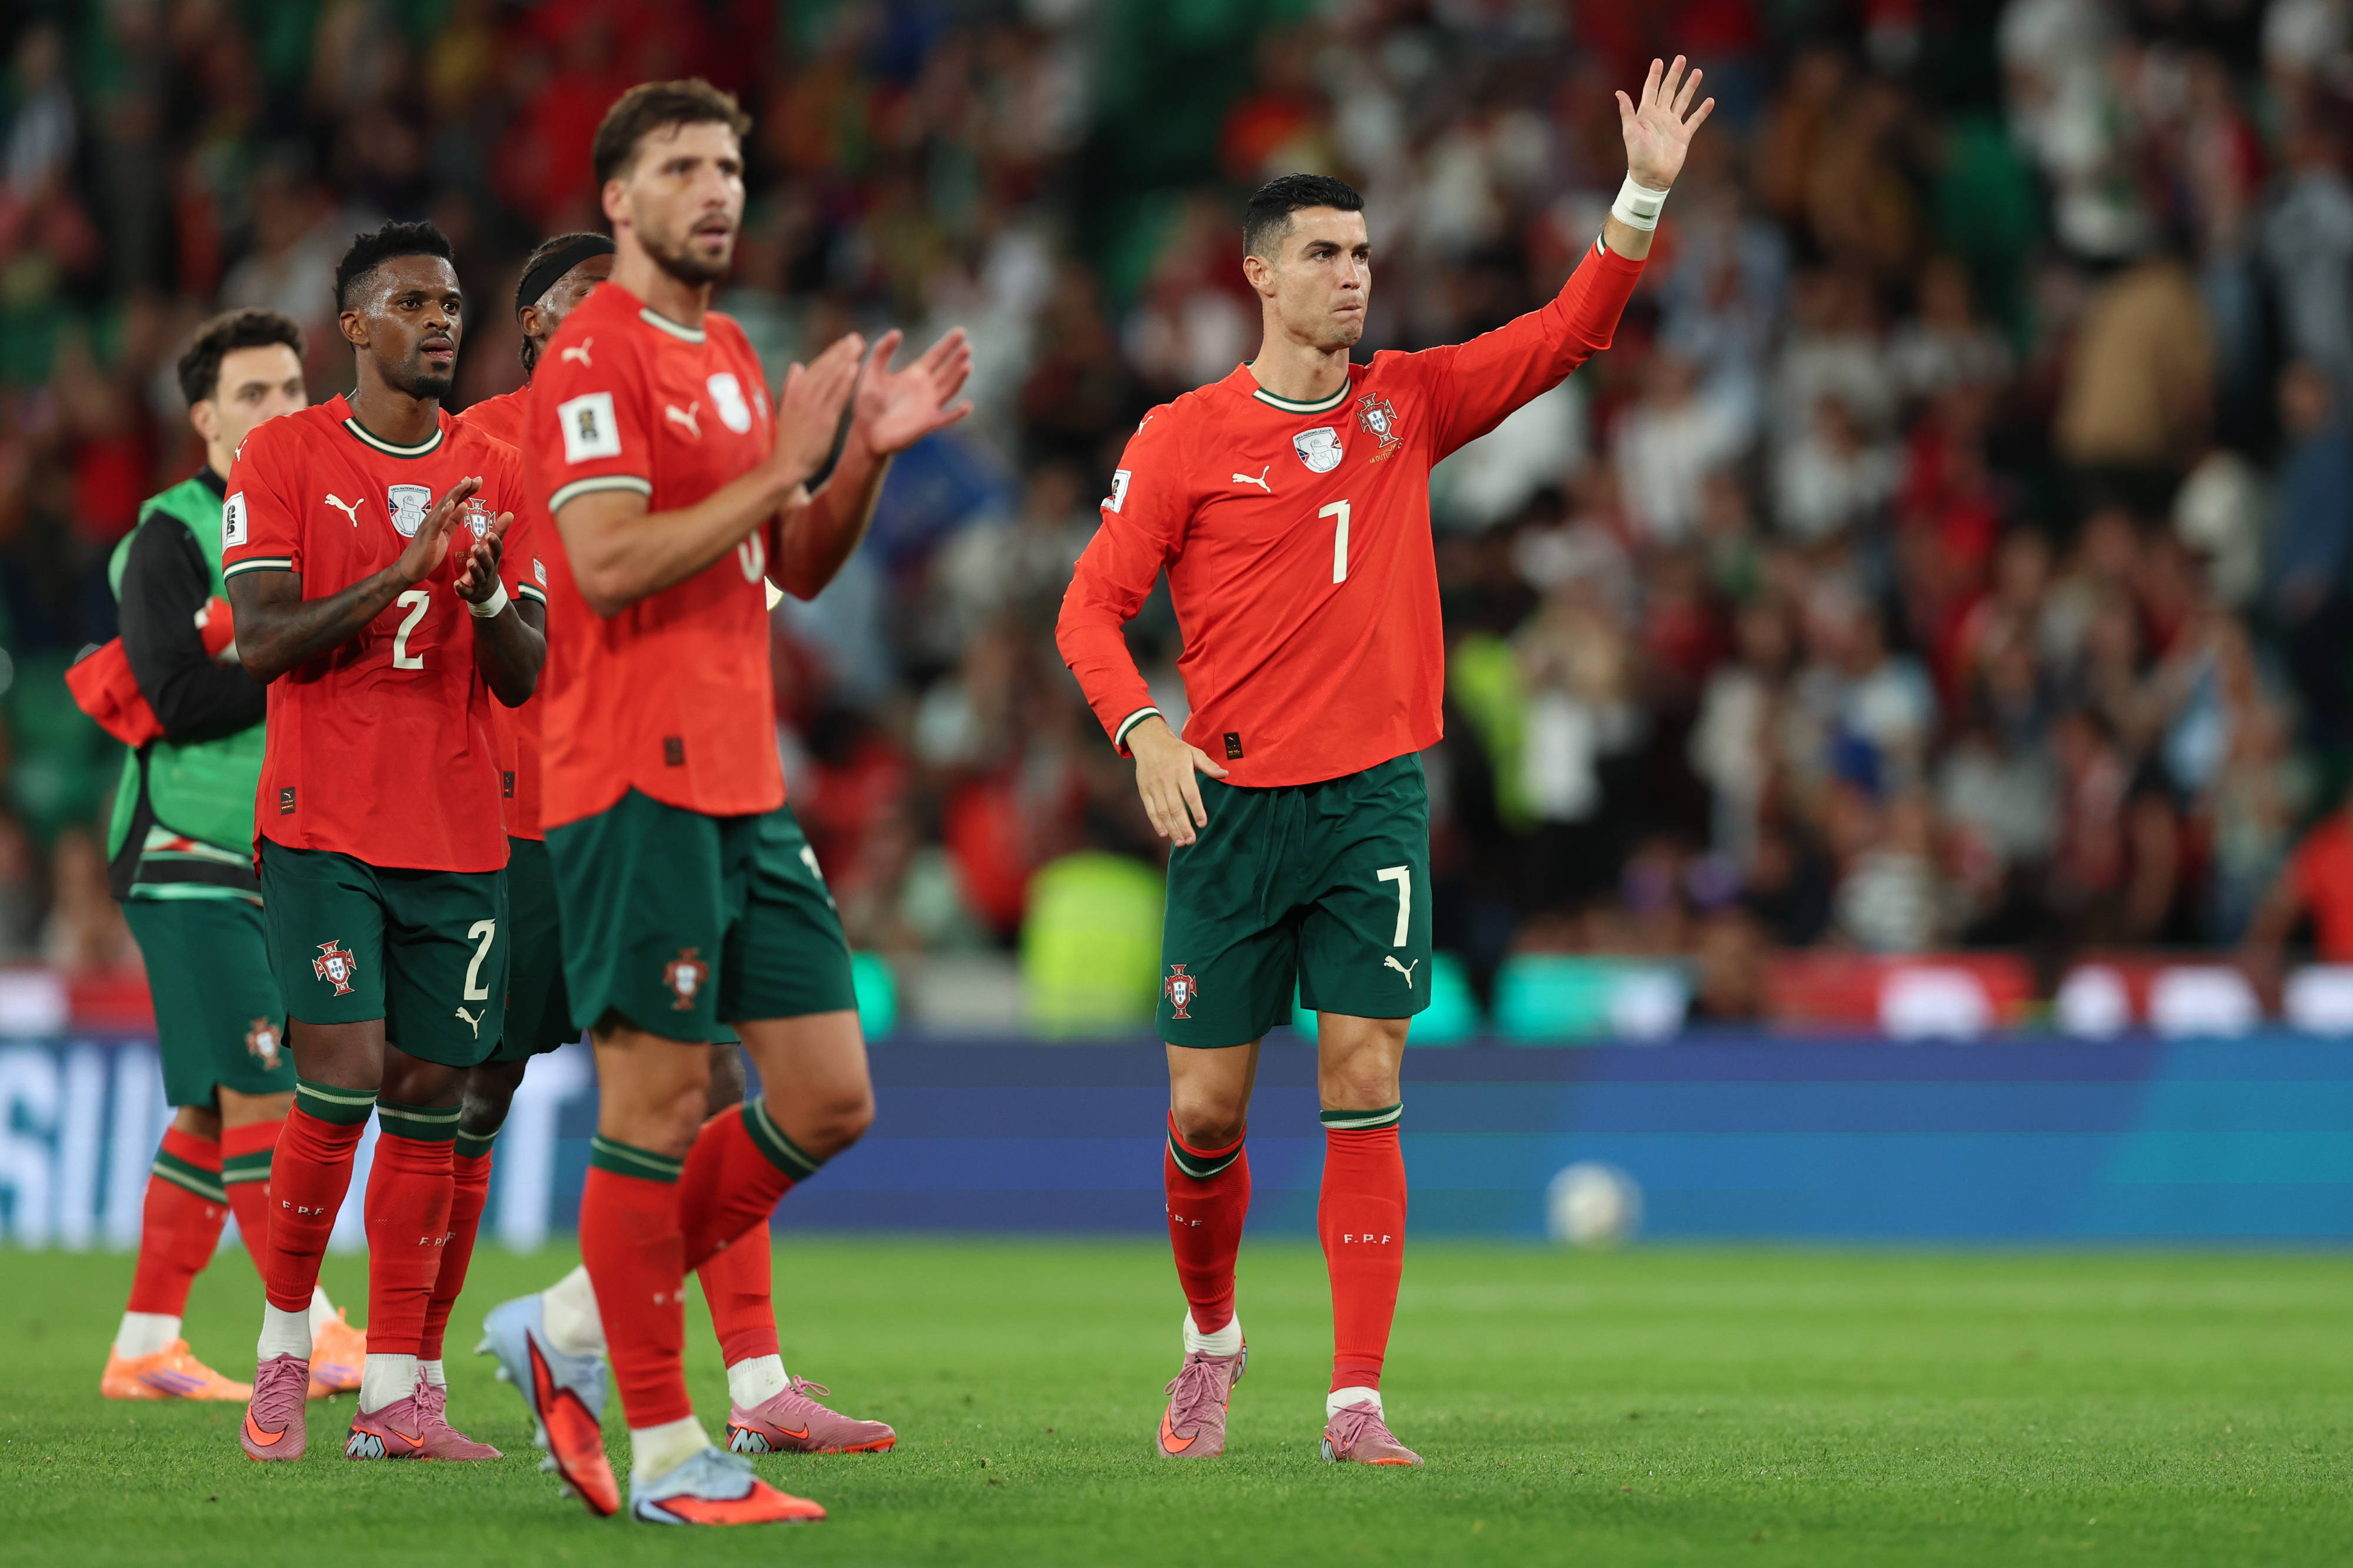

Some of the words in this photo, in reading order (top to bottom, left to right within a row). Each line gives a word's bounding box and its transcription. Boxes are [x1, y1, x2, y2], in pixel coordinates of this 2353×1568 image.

[1318, 499, 1350, 584] 7
[393, 590, 429, 669] 2
[1377, 865, 1411, 947] 7
[464, 918, 496, 1000] 2
